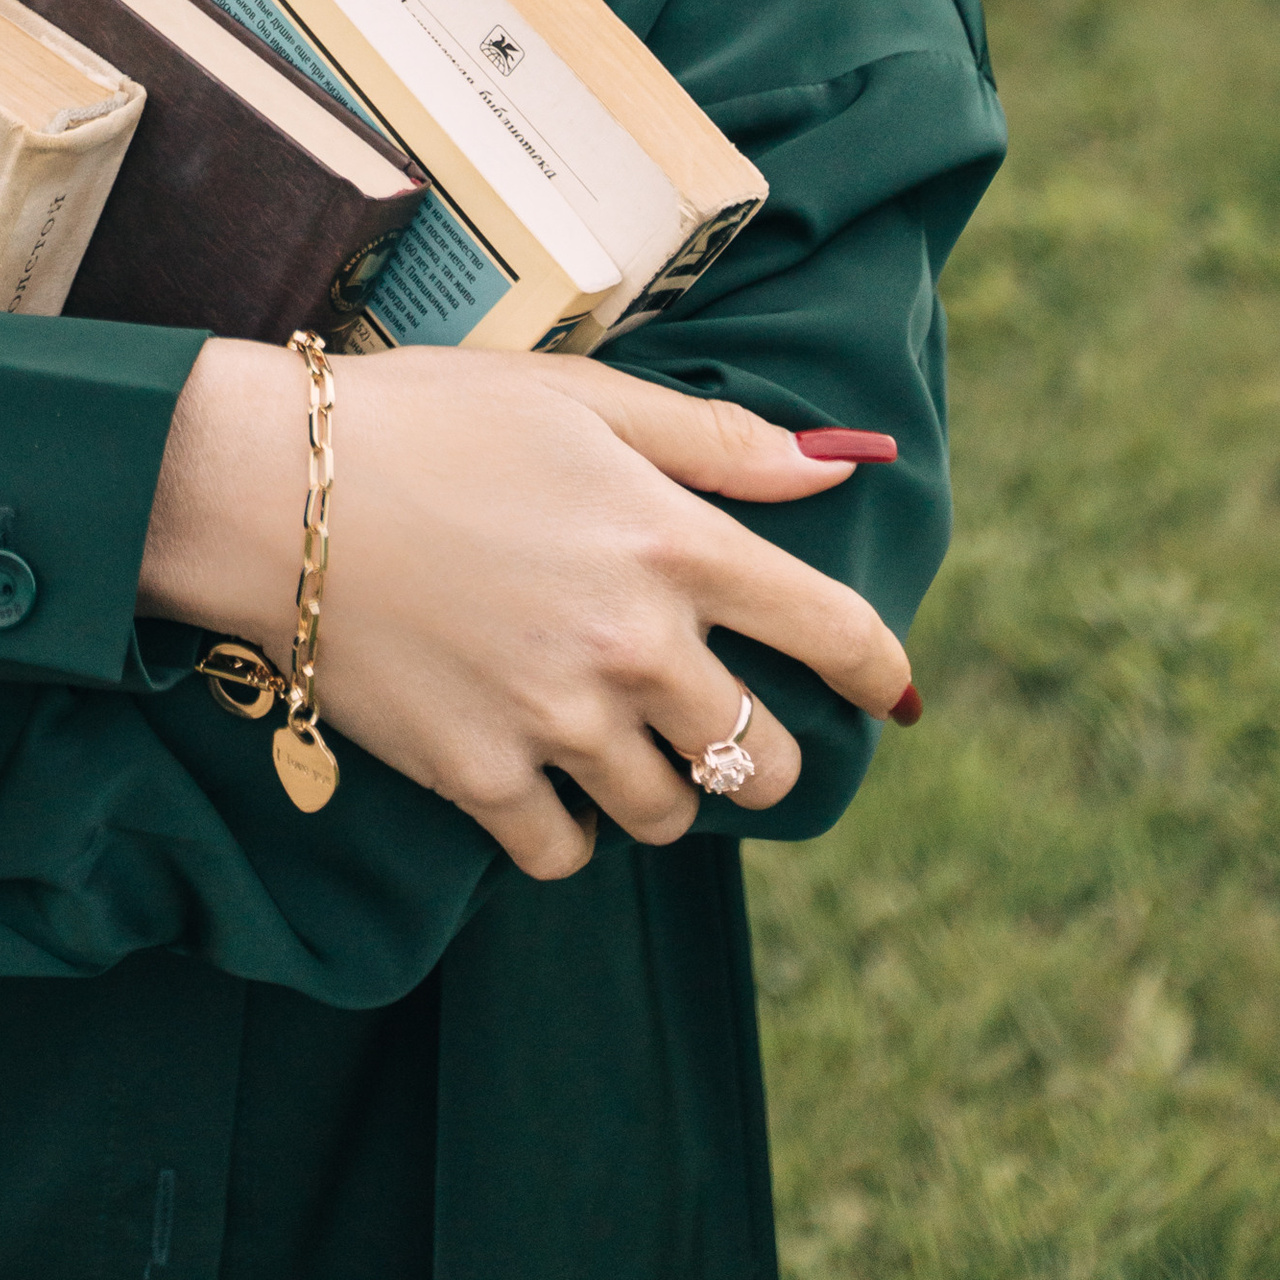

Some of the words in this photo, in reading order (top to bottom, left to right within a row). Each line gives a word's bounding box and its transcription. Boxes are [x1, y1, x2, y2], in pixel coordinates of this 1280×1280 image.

[257, 20, 271, 39] Она
[270, 18, 295, 45] души»
[294, 45, 311, 63] еще
[309, 62, 325, 81] при
[420, 217, 428, 225] и
[426, 224, 449, 251] после
[447, 250, 466, 272] него
[464, 271, 476, 284] не
[431, 209, 443, 222] на
[441, 220, 484, 270] множество
[385, 286, 407, 312] когда
[405, 312, 420, 329] мы
[406, 265, 449, 322] Плюшкины,
[414, 256, 429, 275] лет,
[429, 273, 436, 282] и
[435, 280, 459, 310] поэма
[441, 264, 453, 282] так
[453, 280, 476, 305] живо
[382, 305, 406, 338] поэме.
